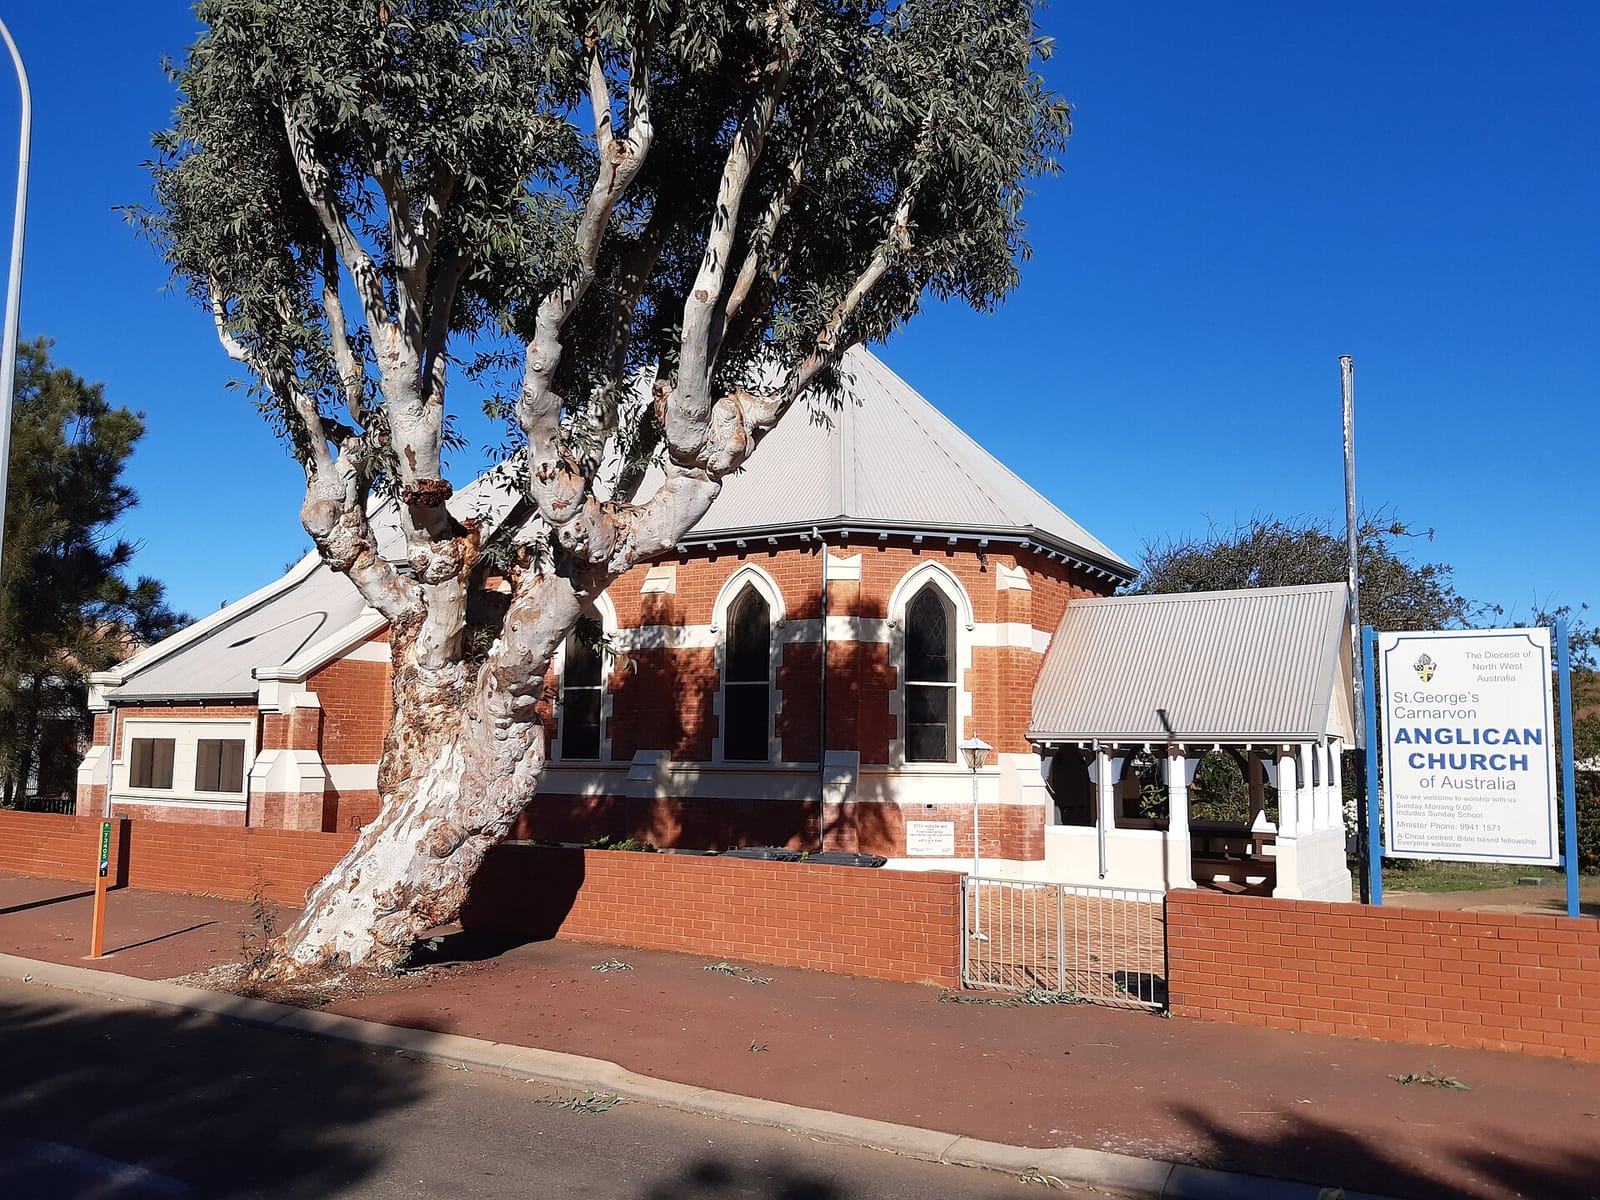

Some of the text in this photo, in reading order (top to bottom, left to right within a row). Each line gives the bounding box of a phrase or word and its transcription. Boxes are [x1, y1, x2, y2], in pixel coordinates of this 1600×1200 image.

[1485, 651, 1520, 659] Diocese
[1473, 662, 1523, 671] North West
[1477, 674, 1516, 682] Australia
[1394, 691, 1479, 705] St.George's
[1395, 707, 1477, 719] Carnarvon
[1394, 728, 1542, 745] ANGLICAN
[1409, 753, 1528, 771] CHURCH
[1420, 776, 1516, 791] of Australia
[1424, 803, 1453, 811] Morning
[1397, 821, 1427, 829] Minister
[1431, 822, 1457, 830] Phone:
[1501, 837, 1536, 845] fellowship
